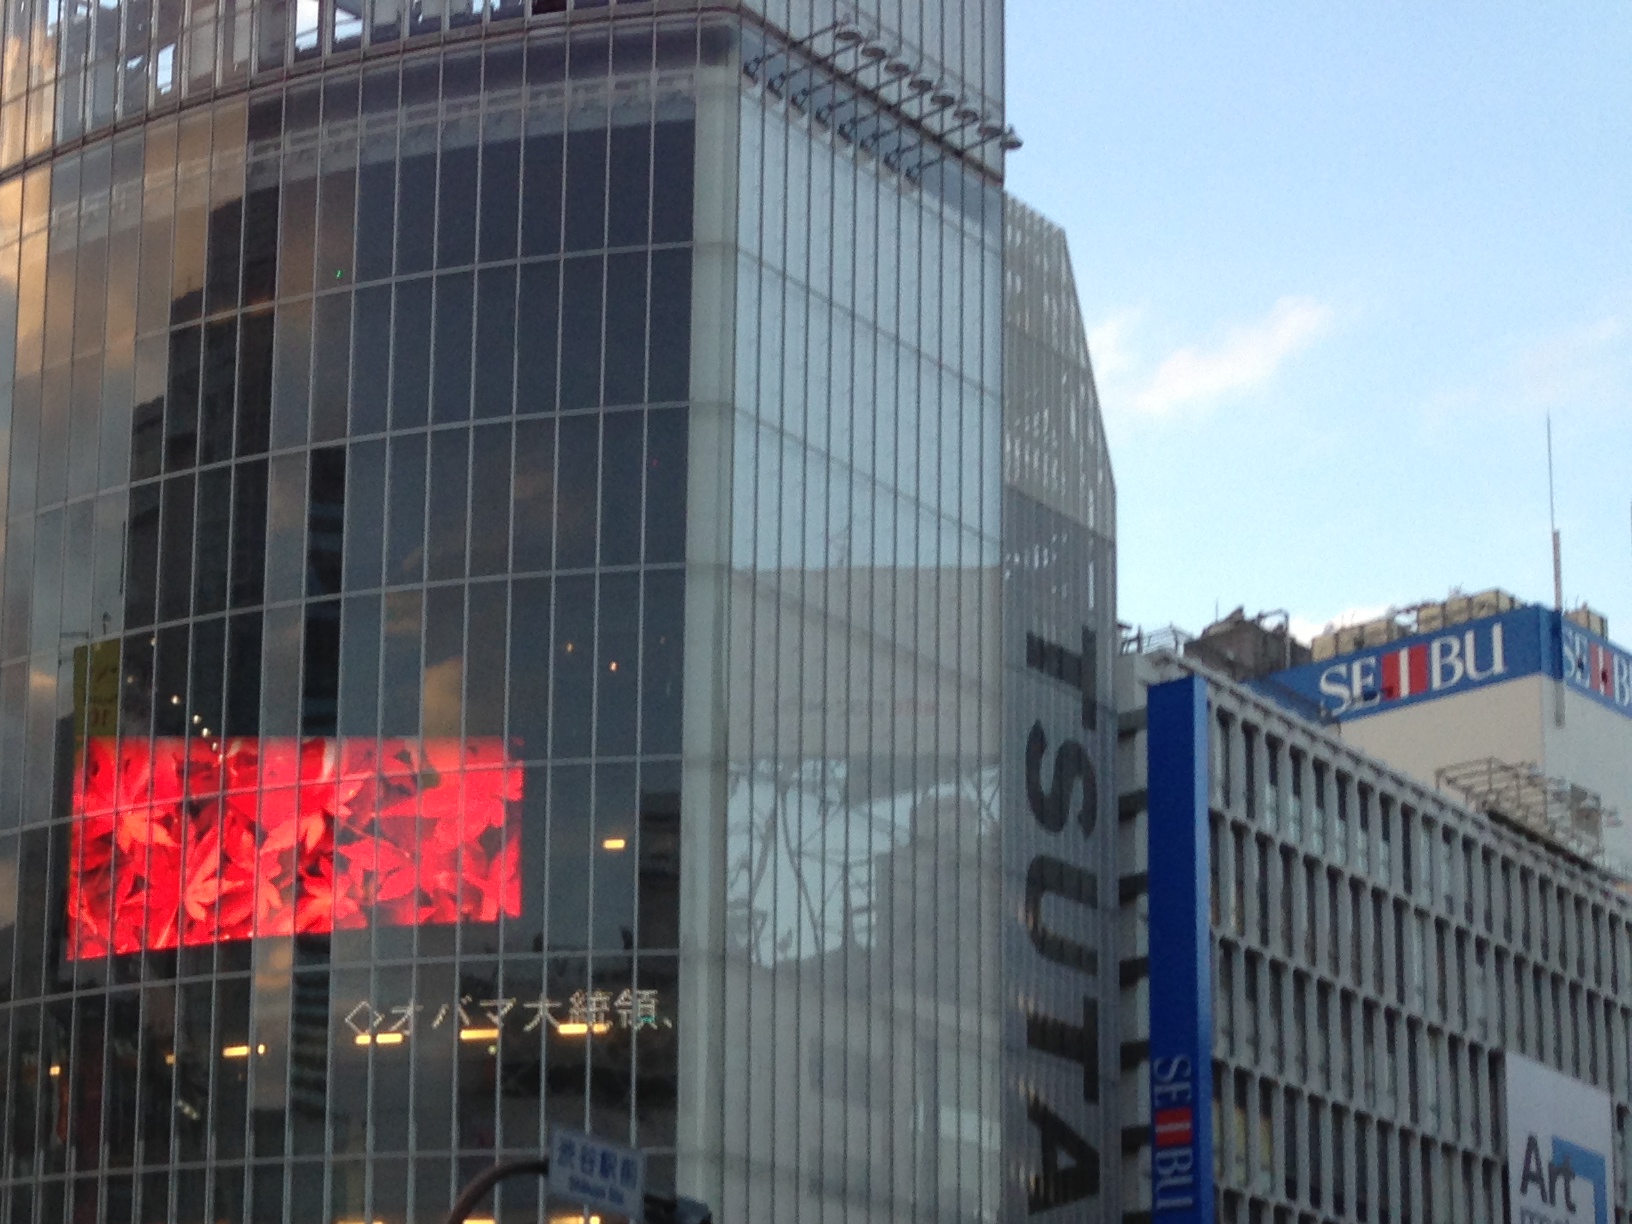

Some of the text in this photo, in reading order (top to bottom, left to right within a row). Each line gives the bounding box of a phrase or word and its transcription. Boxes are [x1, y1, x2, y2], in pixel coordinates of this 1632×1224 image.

[1319, 621, 1505, 718] SEIBU
[1153, 1053, 1193, 1211] SEIBU
[1519, 1131, 1577, 1215] Art
